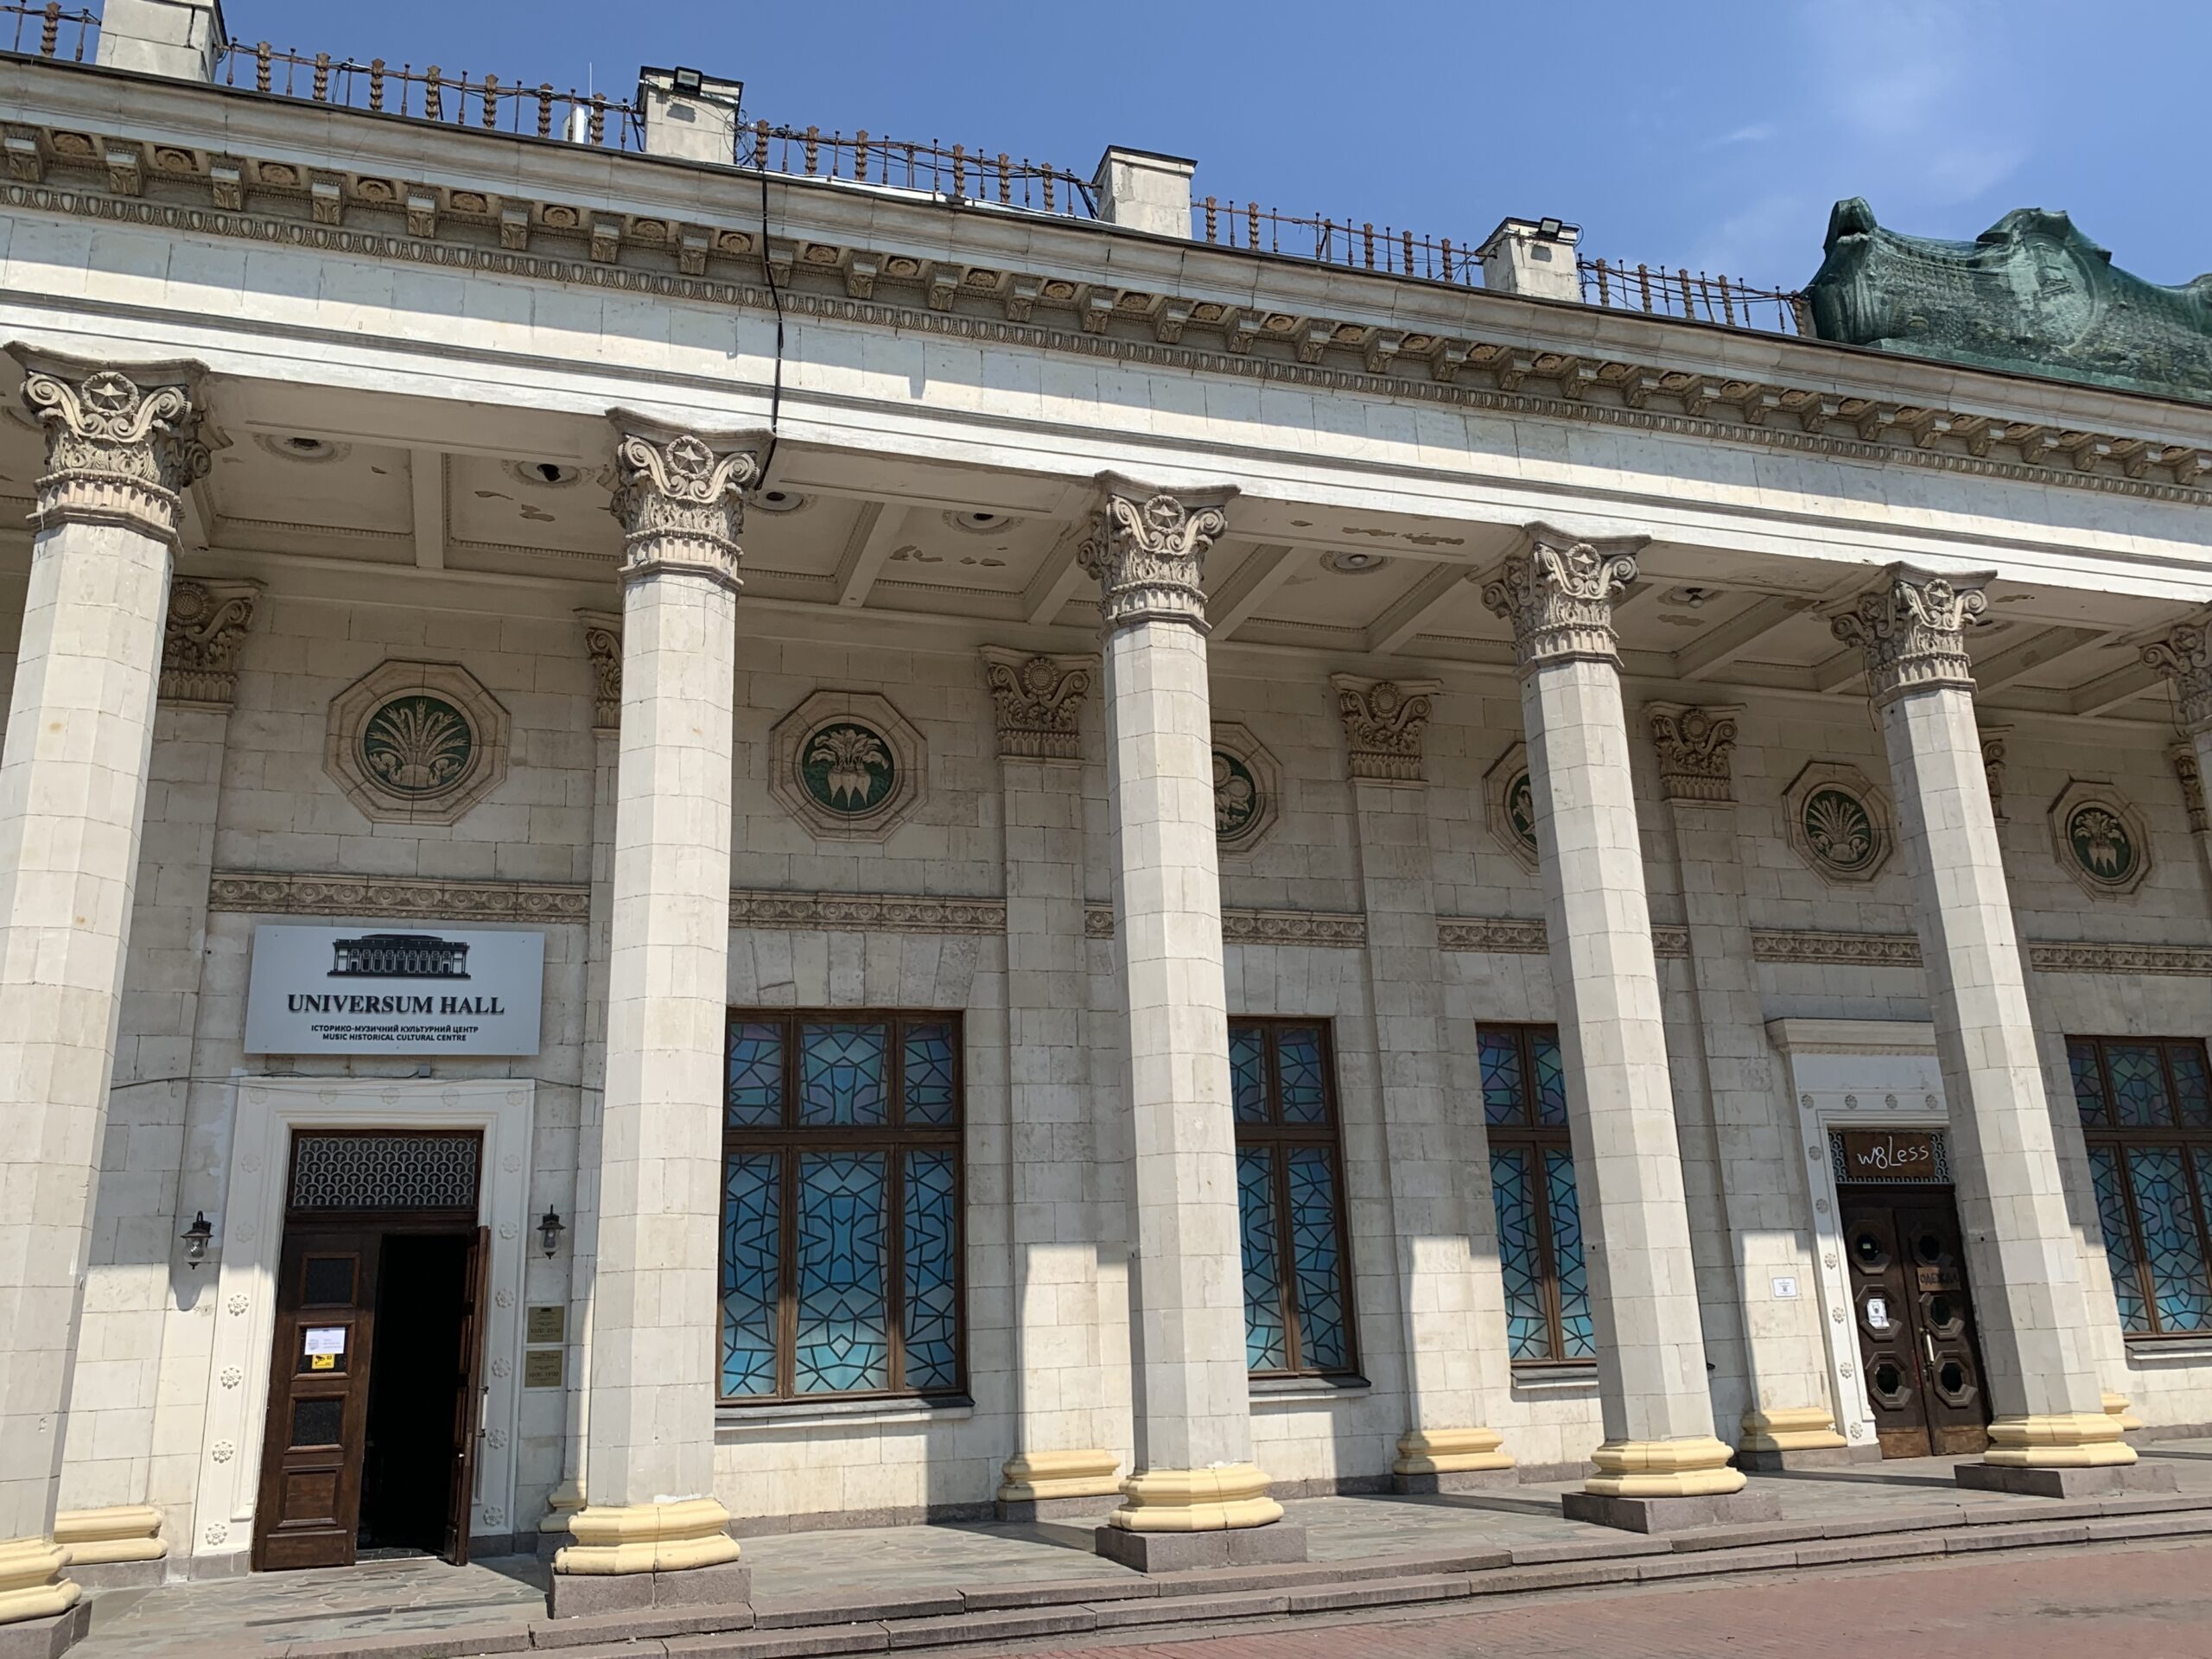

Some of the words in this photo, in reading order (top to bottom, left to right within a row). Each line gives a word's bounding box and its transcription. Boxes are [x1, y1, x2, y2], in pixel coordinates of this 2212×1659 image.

[287, 994, 434, 1014] UNIVERSUM
[439, 996, 505, 1015] HALL
[400, 1025, 451, 1033] КУЛЬТУРНИЙ
